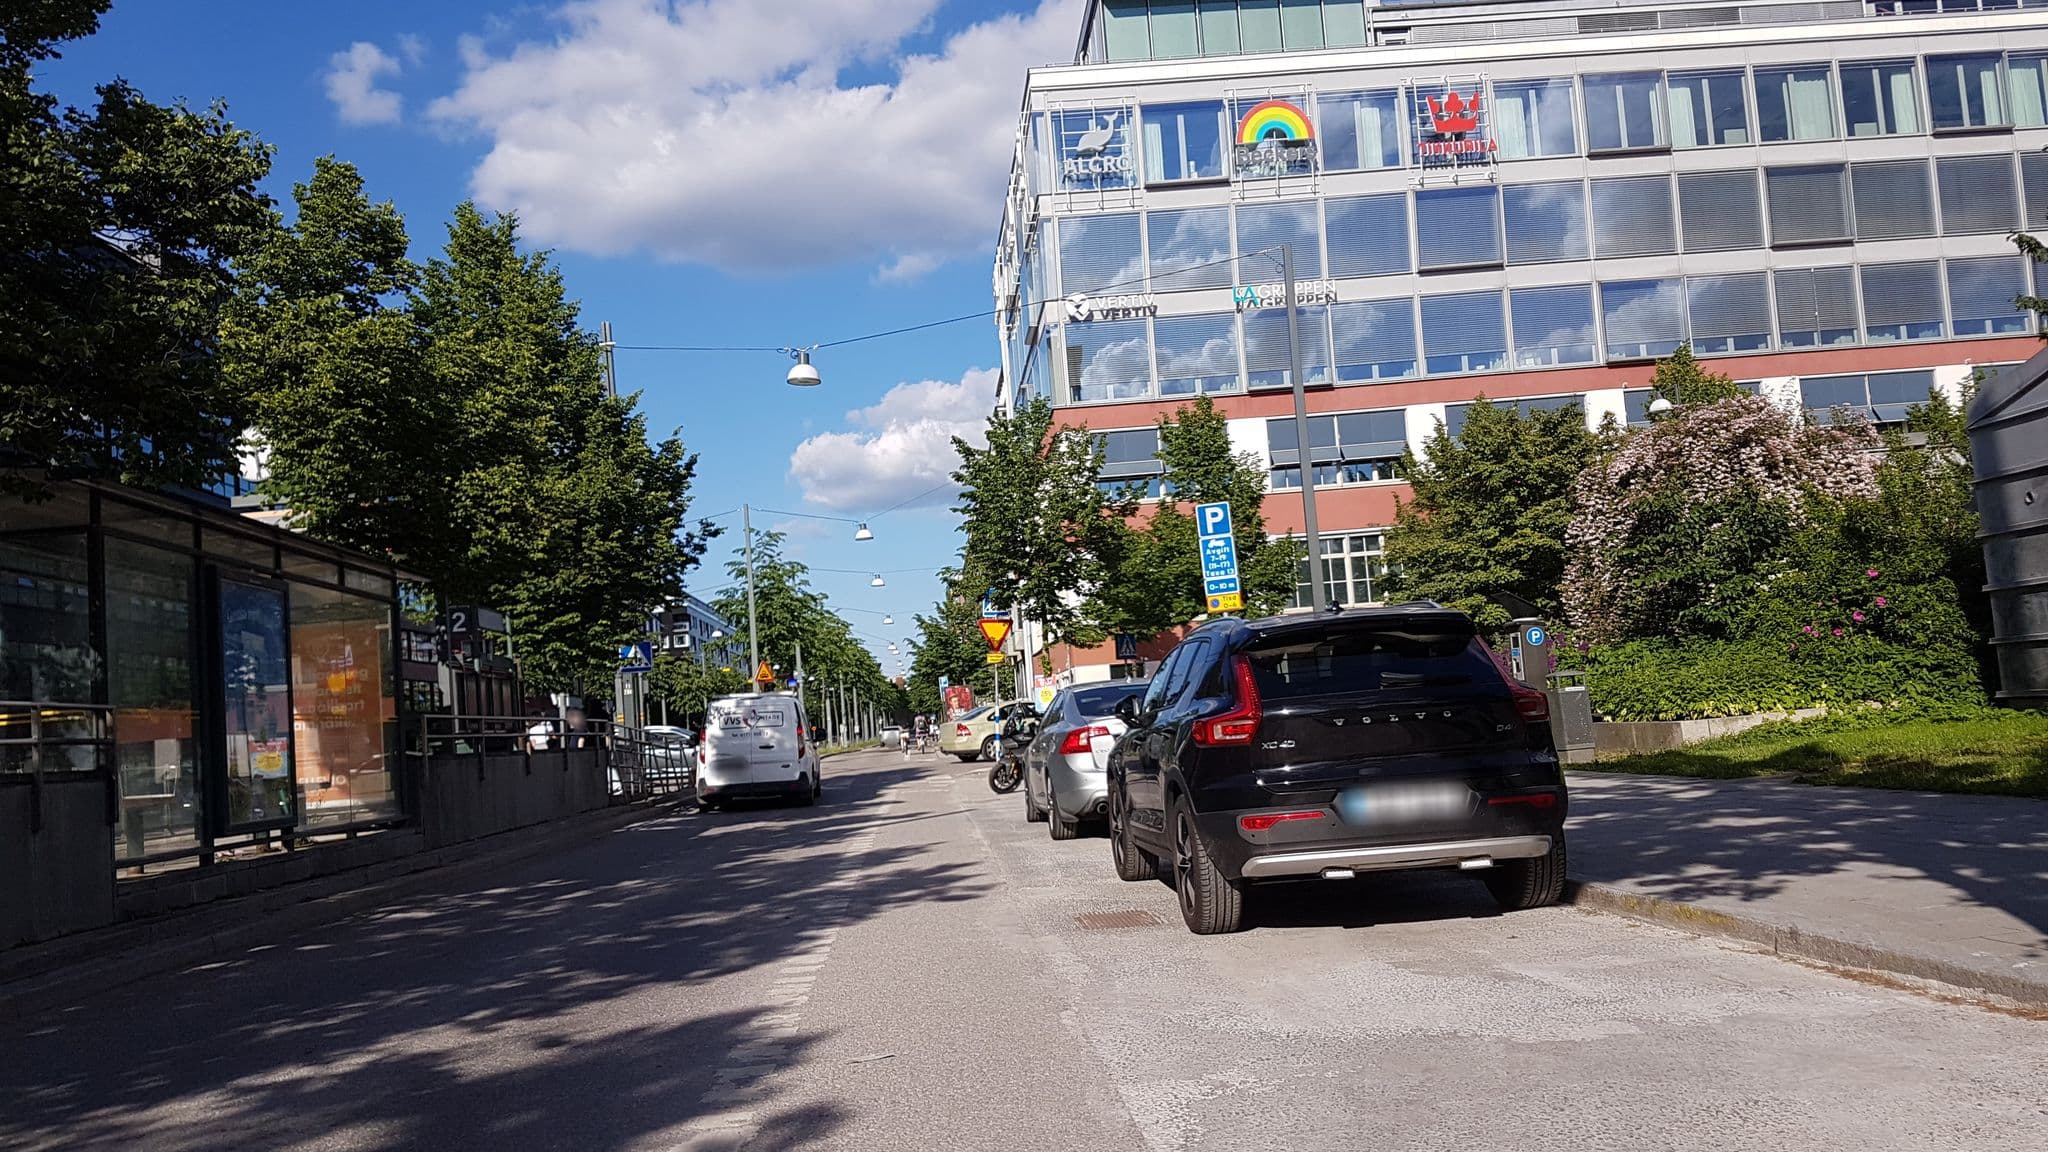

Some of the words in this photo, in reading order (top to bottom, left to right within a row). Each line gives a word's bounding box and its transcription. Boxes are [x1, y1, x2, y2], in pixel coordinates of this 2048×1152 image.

[1063, 155, 1133, 175] ALCRO
[1095, 293, 1155, 309] VERTIV
[1205, 507, 1224, 533] P
[451, 611, 467, 632] 2
[1531, 630, 1541, 643] P
[723, 716, 742, 726] VVS
[1333, 710, 1451, 726] VOLVO
